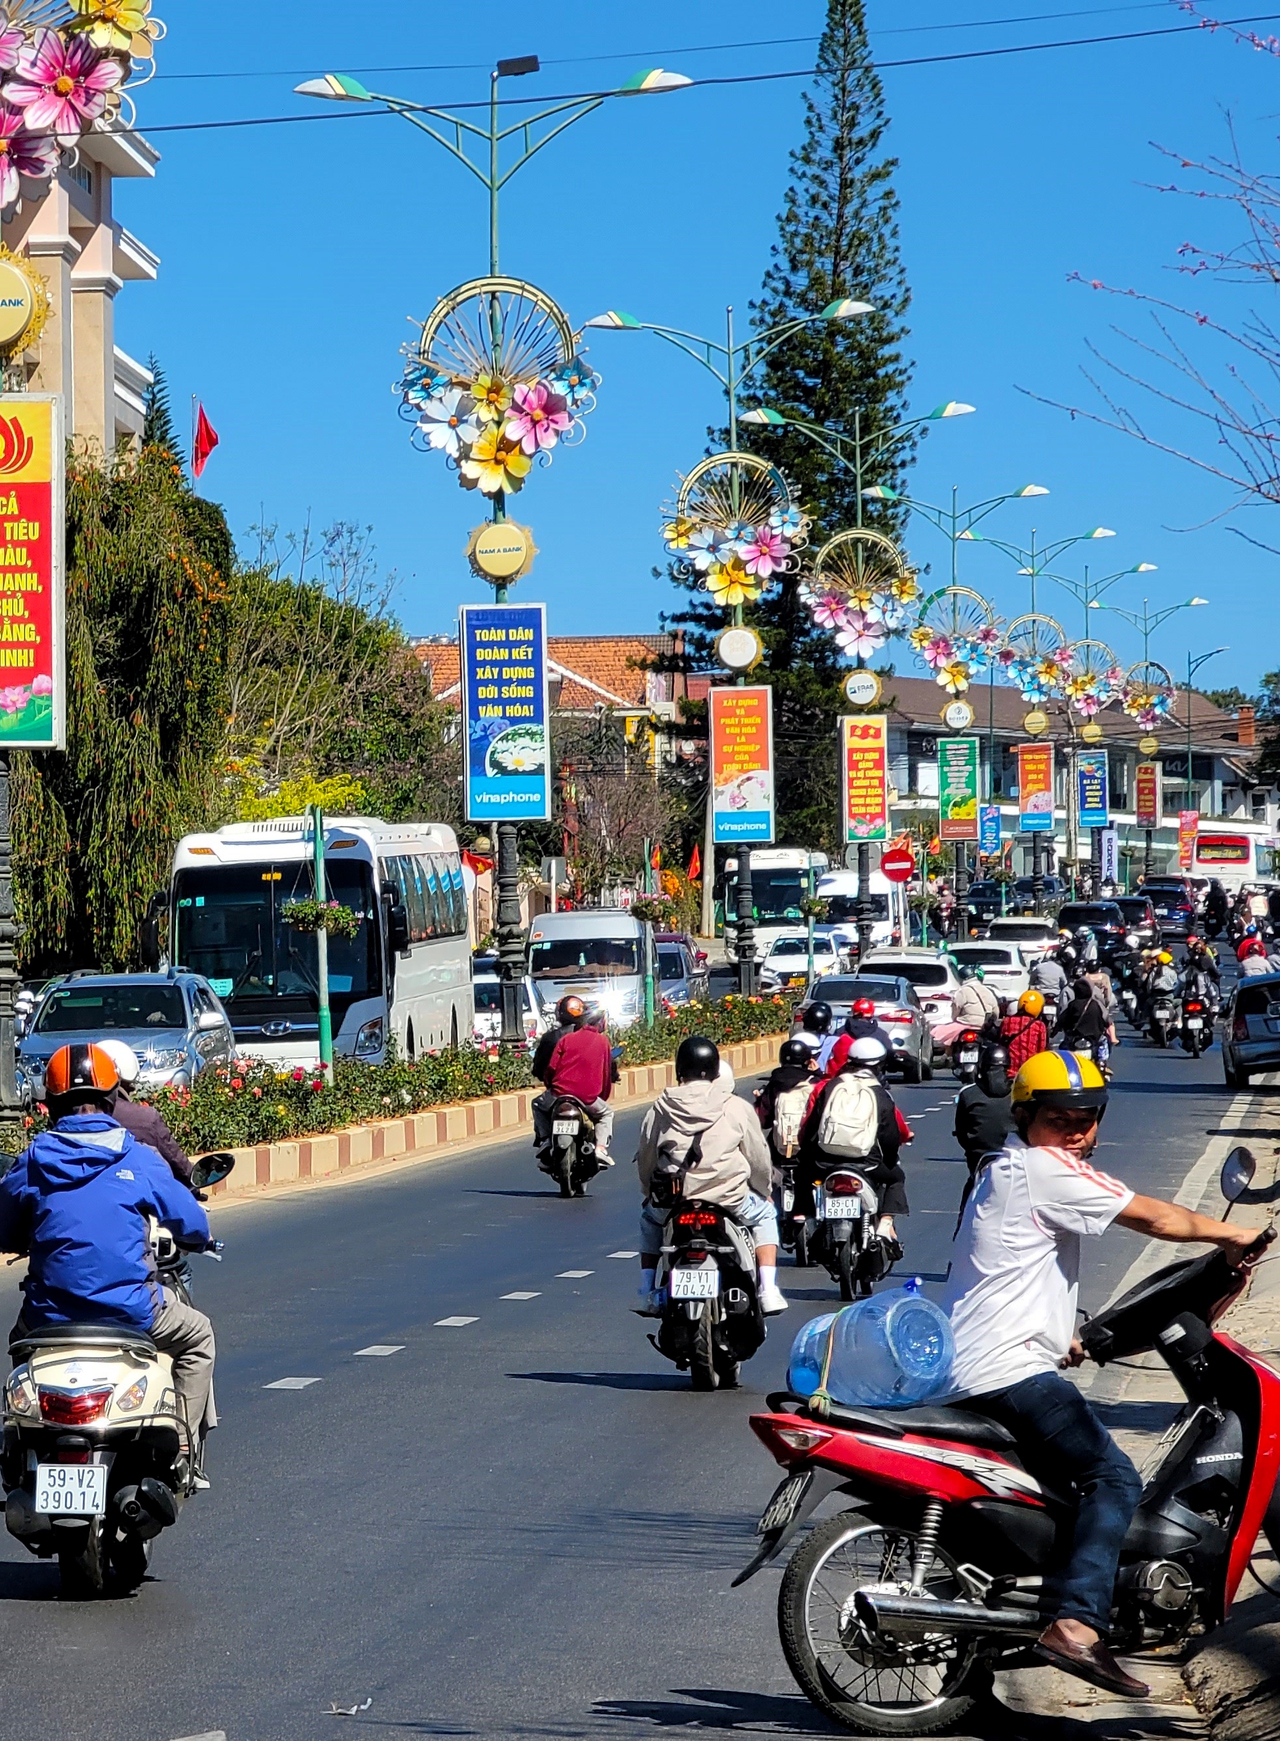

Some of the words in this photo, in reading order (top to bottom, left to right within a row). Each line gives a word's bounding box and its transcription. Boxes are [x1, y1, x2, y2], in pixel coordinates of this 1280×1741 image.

[4, 519, 39, 540] TIÊU
[475, 627, 506, 641] TOÀN
[509, 626, 534, 640] DÂN
[476, 646, 509, 660] ĐOÀN
[512, 644, 533, 659] KẾT
[476, 665, 499, 679] XÂY
[502, 666, 535, 681] DỰNG
[478, 684, 498, 698] ĐỜI
[501, 682, 534, 698] SỐNG
[478, 703, 503, 717] VĂN
[506, 703, 534, 717] HÓA!
[474, 791, 541, 804] vinaphone
[718, 821, 767, 832] vinaphone
[679, 1272, 709, 1283] 79-Y1
[675, 1284, 713, 1296] 704.24
[1195, 1452, 1243, 1464] HONDA
[48, 1469, 95, 1488] 59-V2
[40, 1491, 100, 1510] 390.14
